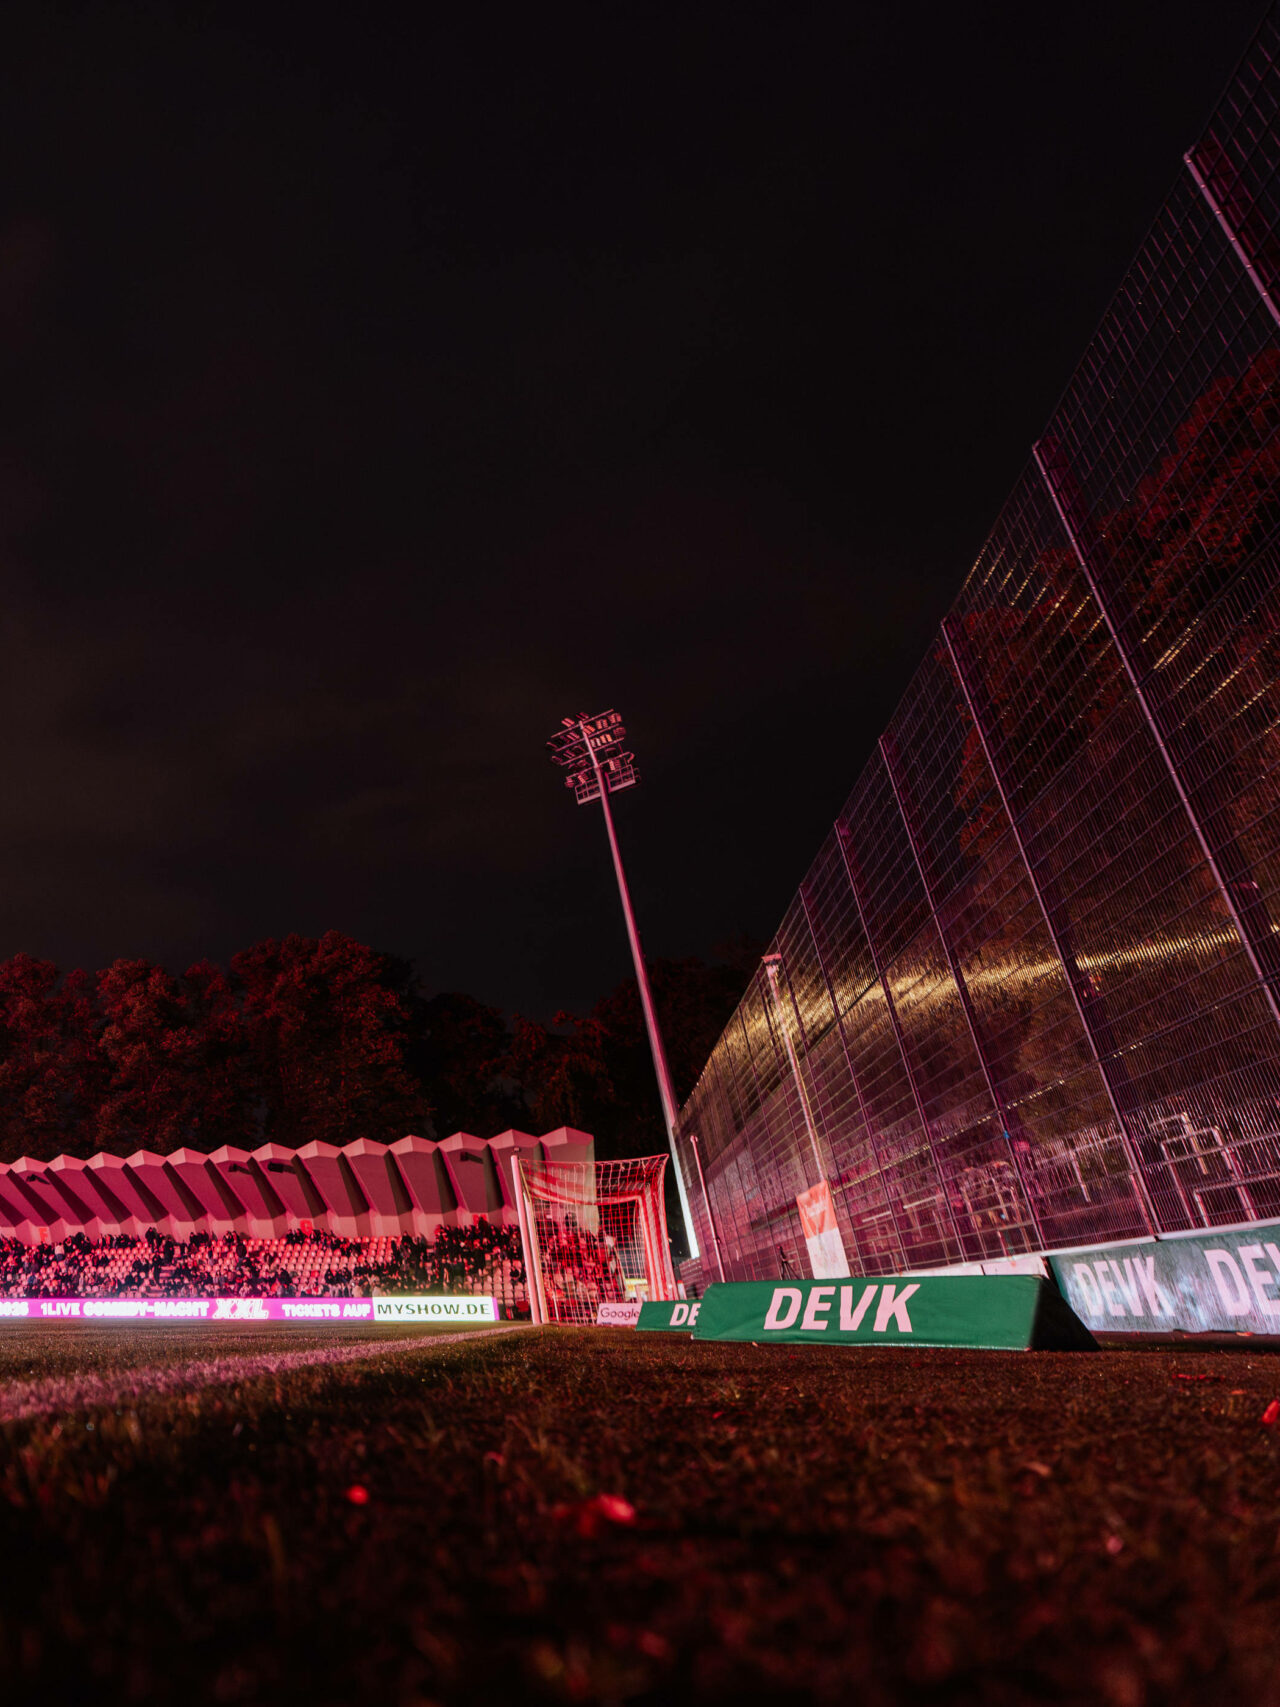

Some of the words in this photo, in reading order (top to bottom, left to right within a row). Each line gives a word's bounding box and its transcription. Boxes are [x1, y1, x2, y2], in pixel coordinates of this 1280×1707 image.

[1074, 1256, 1176, 1317] DEVK
[1204, 1243, 1280, 1317] DE
[41, 1302, 80, 1316] 1LIVE
[83, 1301, 210, 1316] COMEDY-NACHT
[213, 1298, 269, 1319] XXL
[282, 1303, 340, 1317] TICKETS
[343, 1303, 371, 1317] AUF
[377, 1304, 491, 1315] MYSHOW.DE
[600, 1307, 640, 1321] Google
[669, 1303, 701, 1326] DE
[763, 1284, 921, 1332] DEVK
